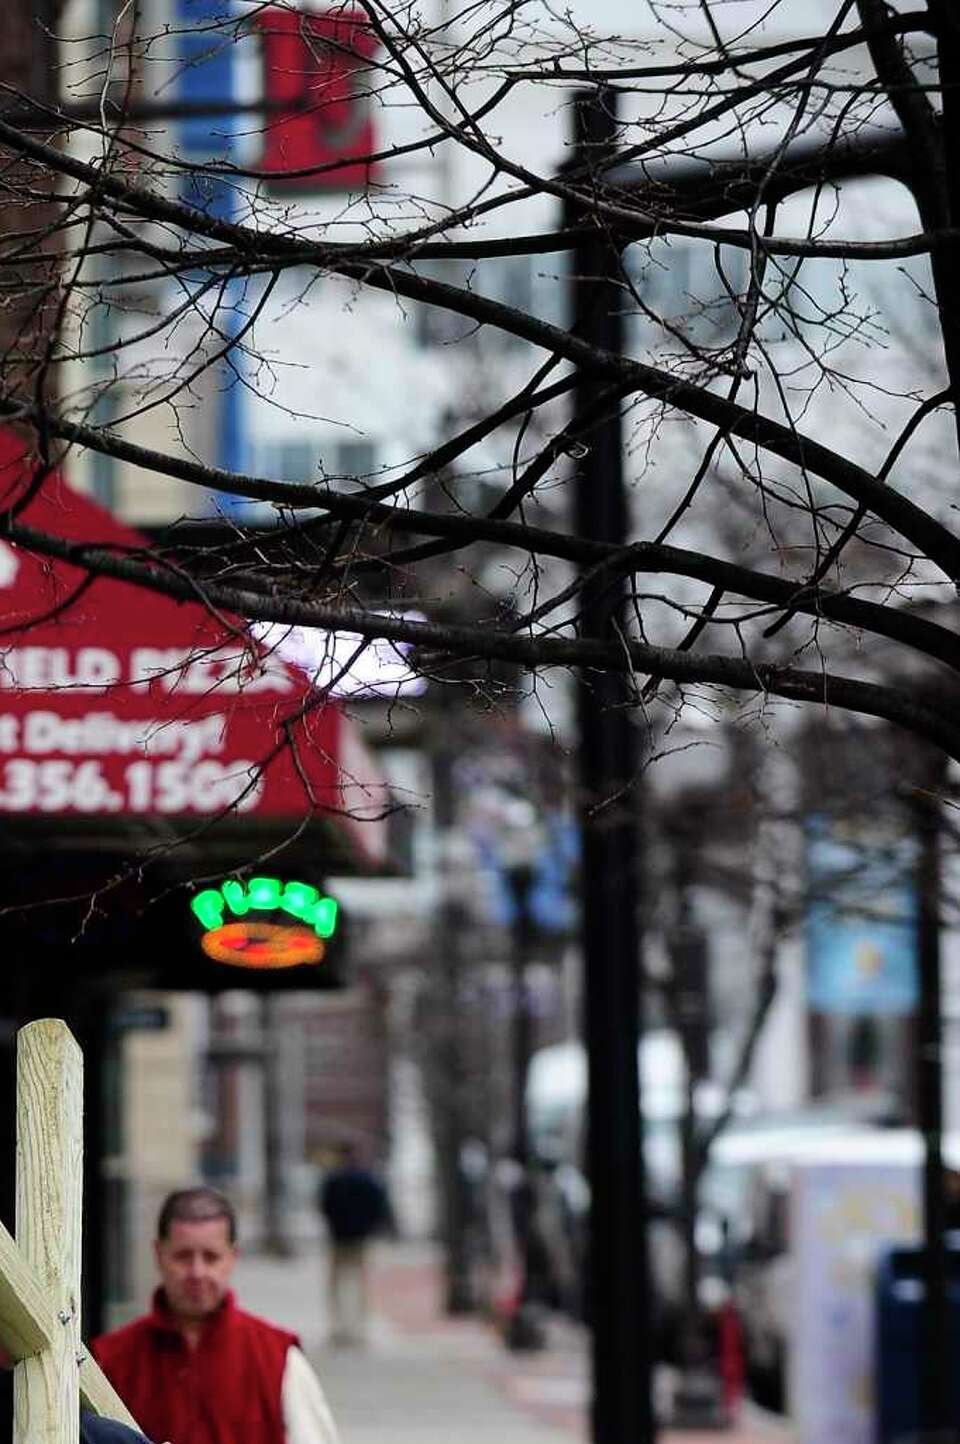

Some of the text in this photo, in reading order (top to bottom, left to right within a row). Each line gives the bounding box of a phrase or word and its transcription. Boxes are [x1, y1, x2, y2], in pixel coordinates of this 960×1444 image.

[130, 646, 296, 694] PIZZA
[25, 712, 228, 761] Delivery!
[191, 877, 338, 938] PIZZA
